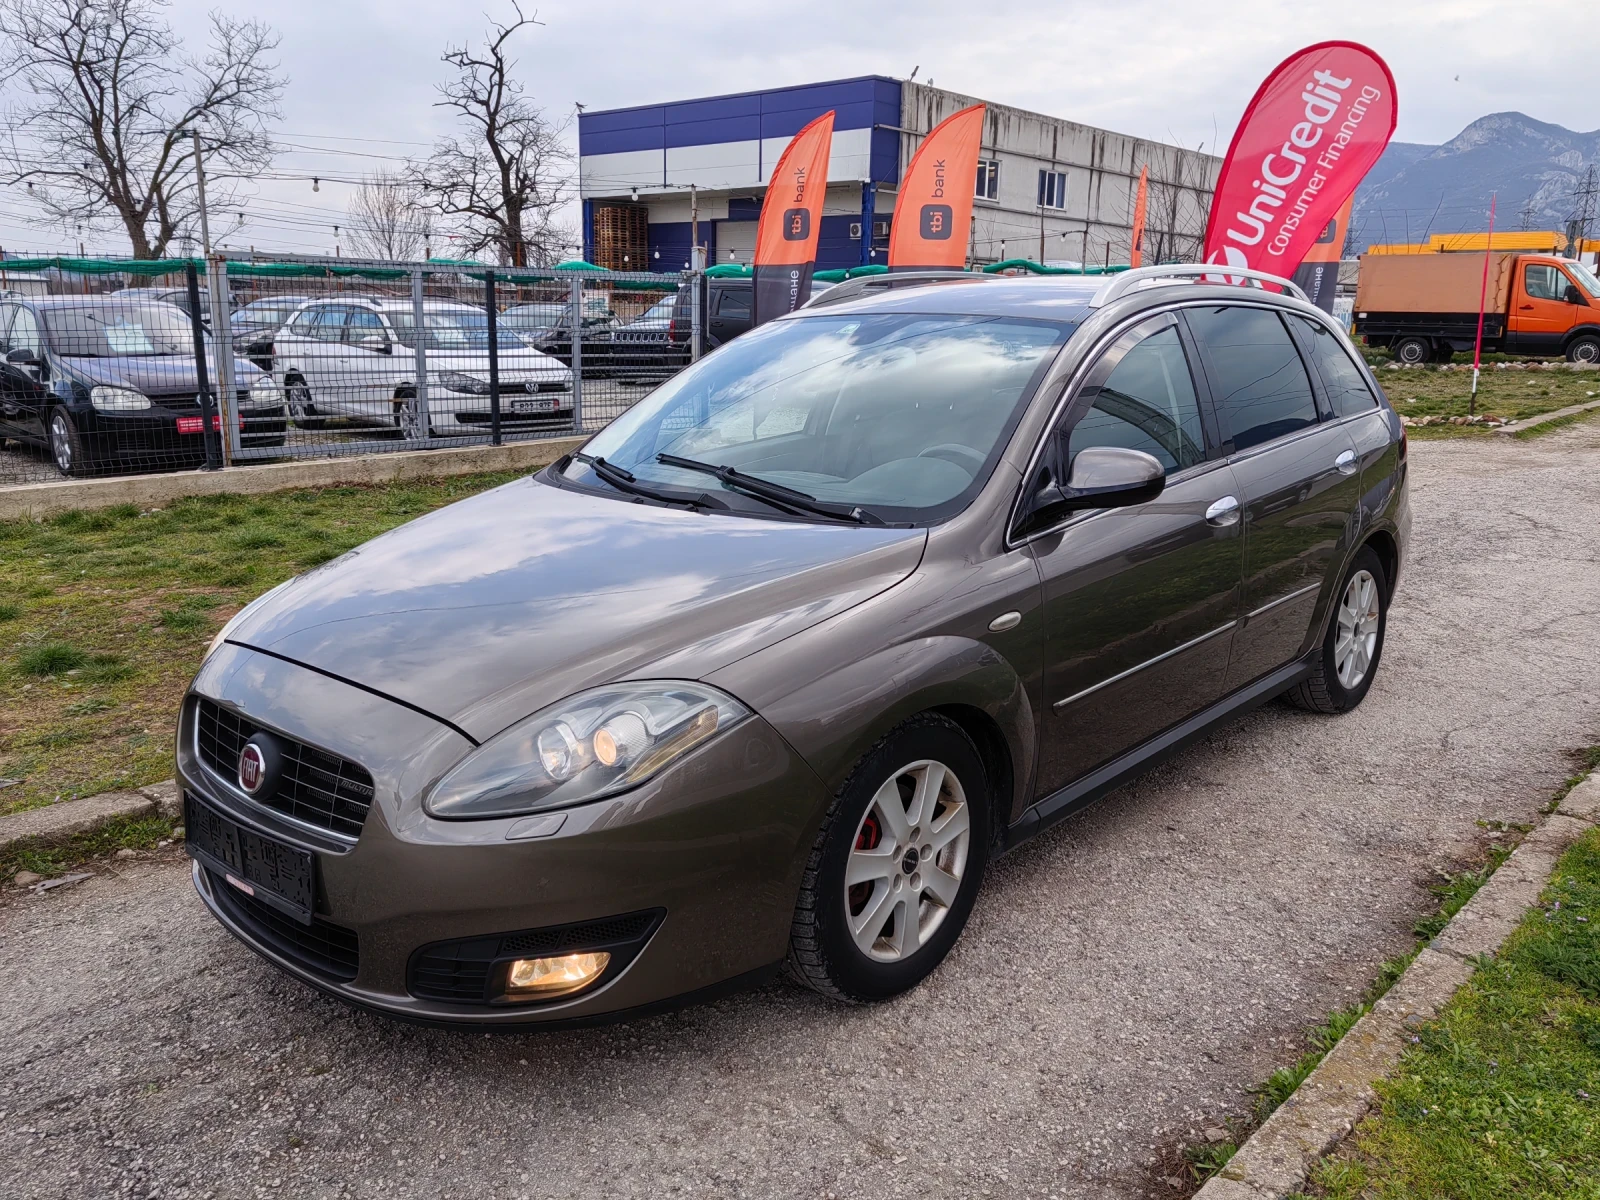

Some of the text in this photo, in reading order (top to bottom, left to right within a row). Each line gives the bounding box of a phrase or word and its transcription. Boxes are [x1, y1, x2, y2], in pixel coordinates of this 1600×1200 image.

[1226, 69, 1353, 246] UniCredit
[1267, 85, 1381, 256] Consumer Financing
[791, 166, 806, 235] tbi bank
[929, 159, 946, 233] tbi bank
[242, 757, 258, 782] FIAT
[340, 780, 374, 796] MULTIJE
